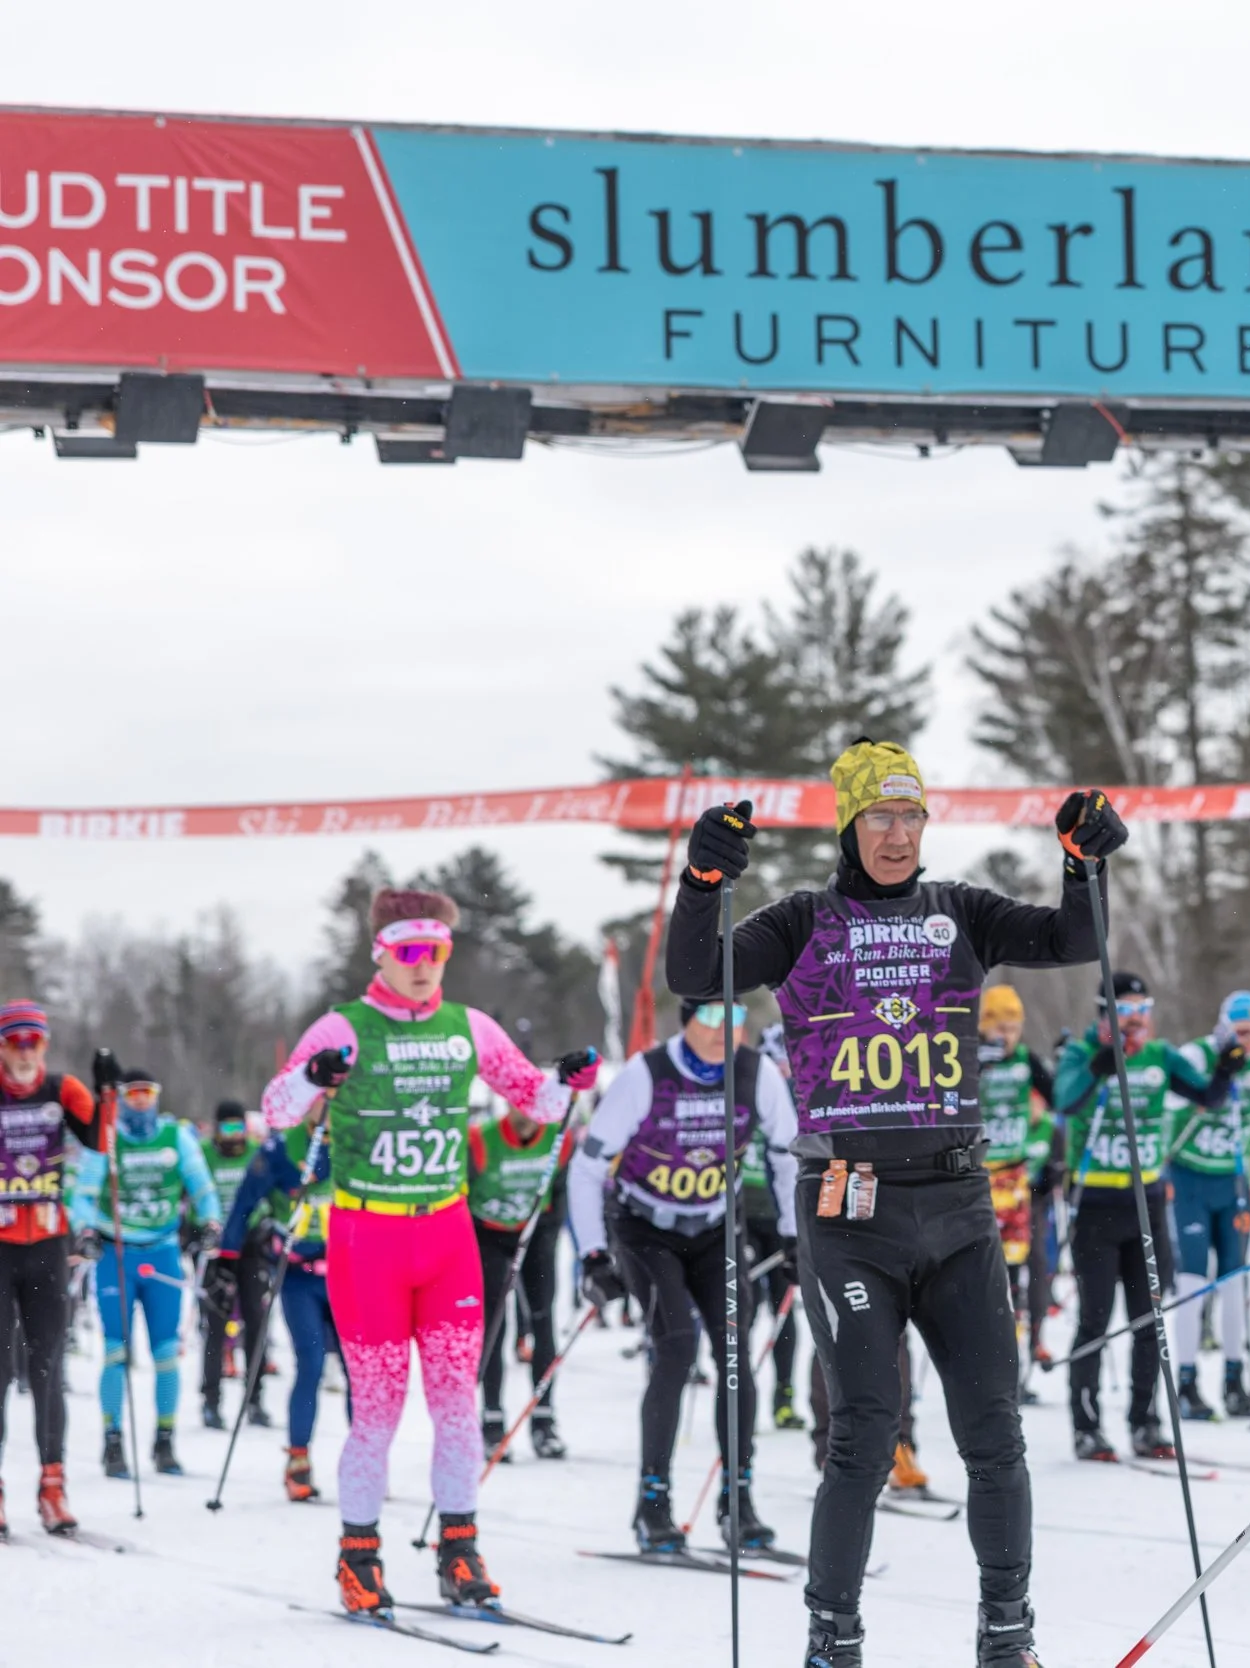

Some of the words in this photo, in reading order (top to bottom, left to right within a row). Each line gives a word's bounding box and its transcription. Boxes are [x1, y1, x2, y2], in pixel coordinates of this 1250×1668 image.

[115, 173, 348, 243] TITLE
[0, 244, 287, 315] ONSOR
[854, 947, 885, 962] Run.
[887, 944, 919, 959] Bike.
[855, 965, 931, 981] PIONEER
[831, 1032, 963, 1092] 4013
[826, 1103, 870, 1117] American
[370, 1127, 463, 1177] 4522
